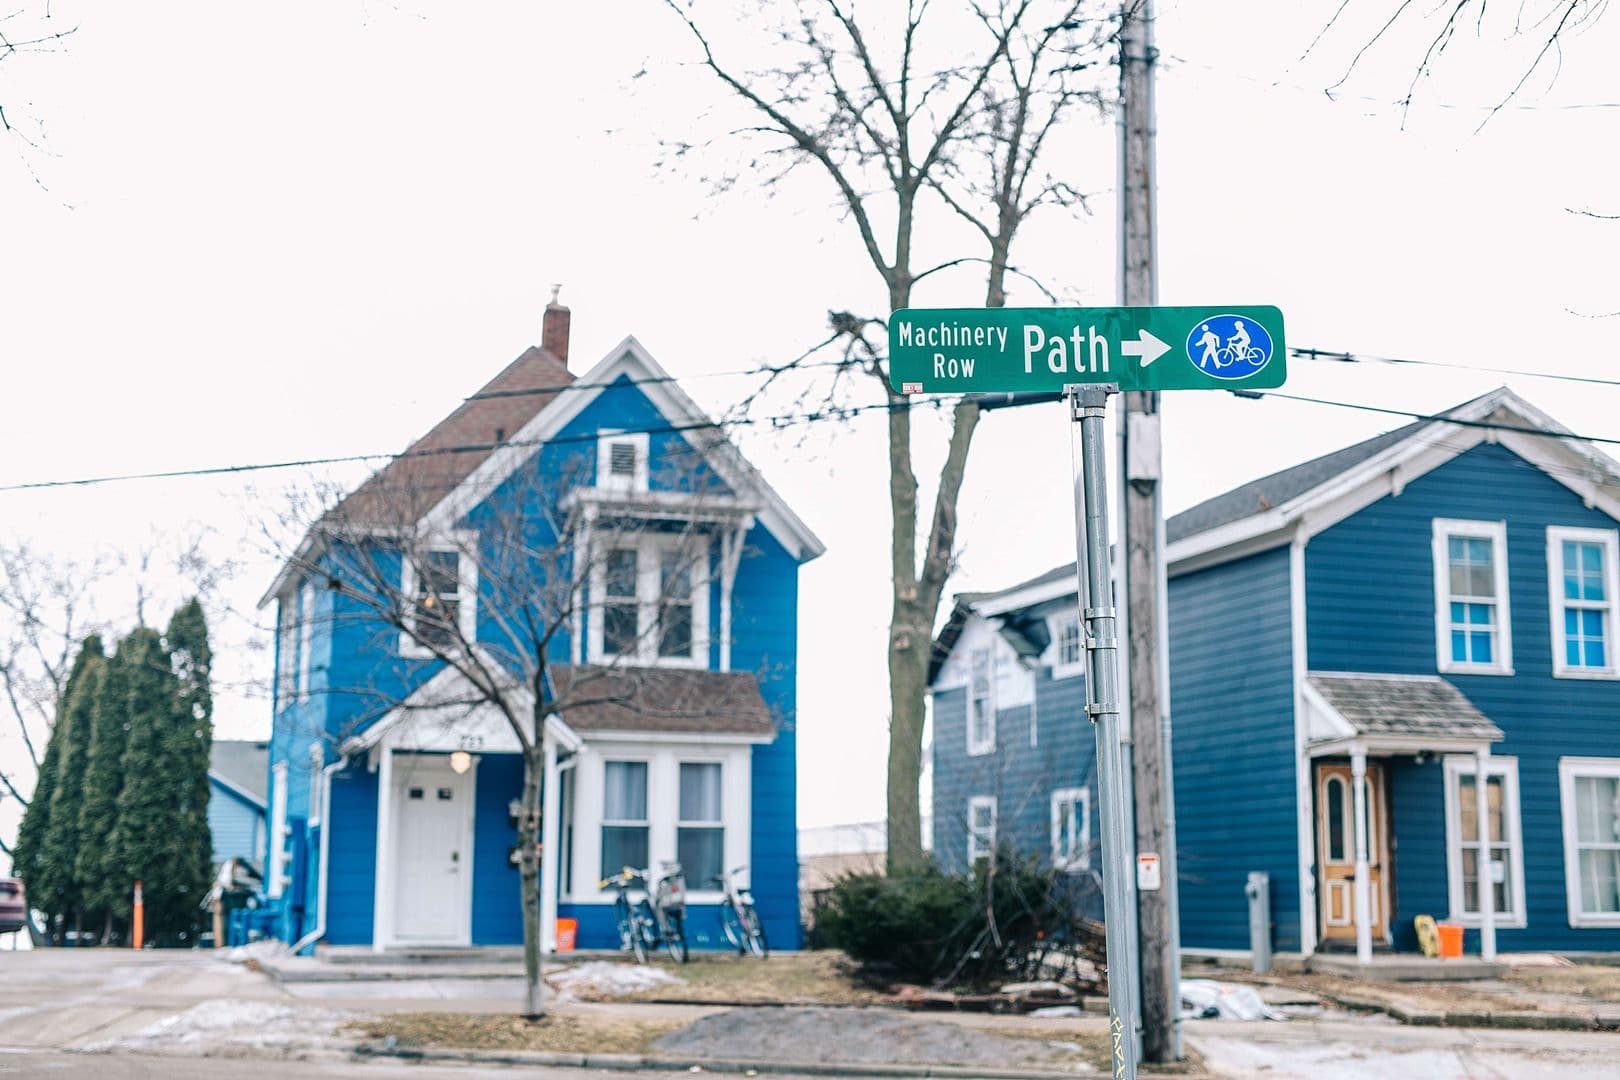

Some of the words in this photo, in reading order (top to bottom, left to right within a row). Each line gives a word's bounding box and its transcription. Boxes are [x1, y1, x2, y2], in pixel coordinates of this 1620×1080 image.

[898, 321, 1008, 353] Machinery
[1023, 324, 1110, 374] Path
[933, 353, 976, 379] Row
